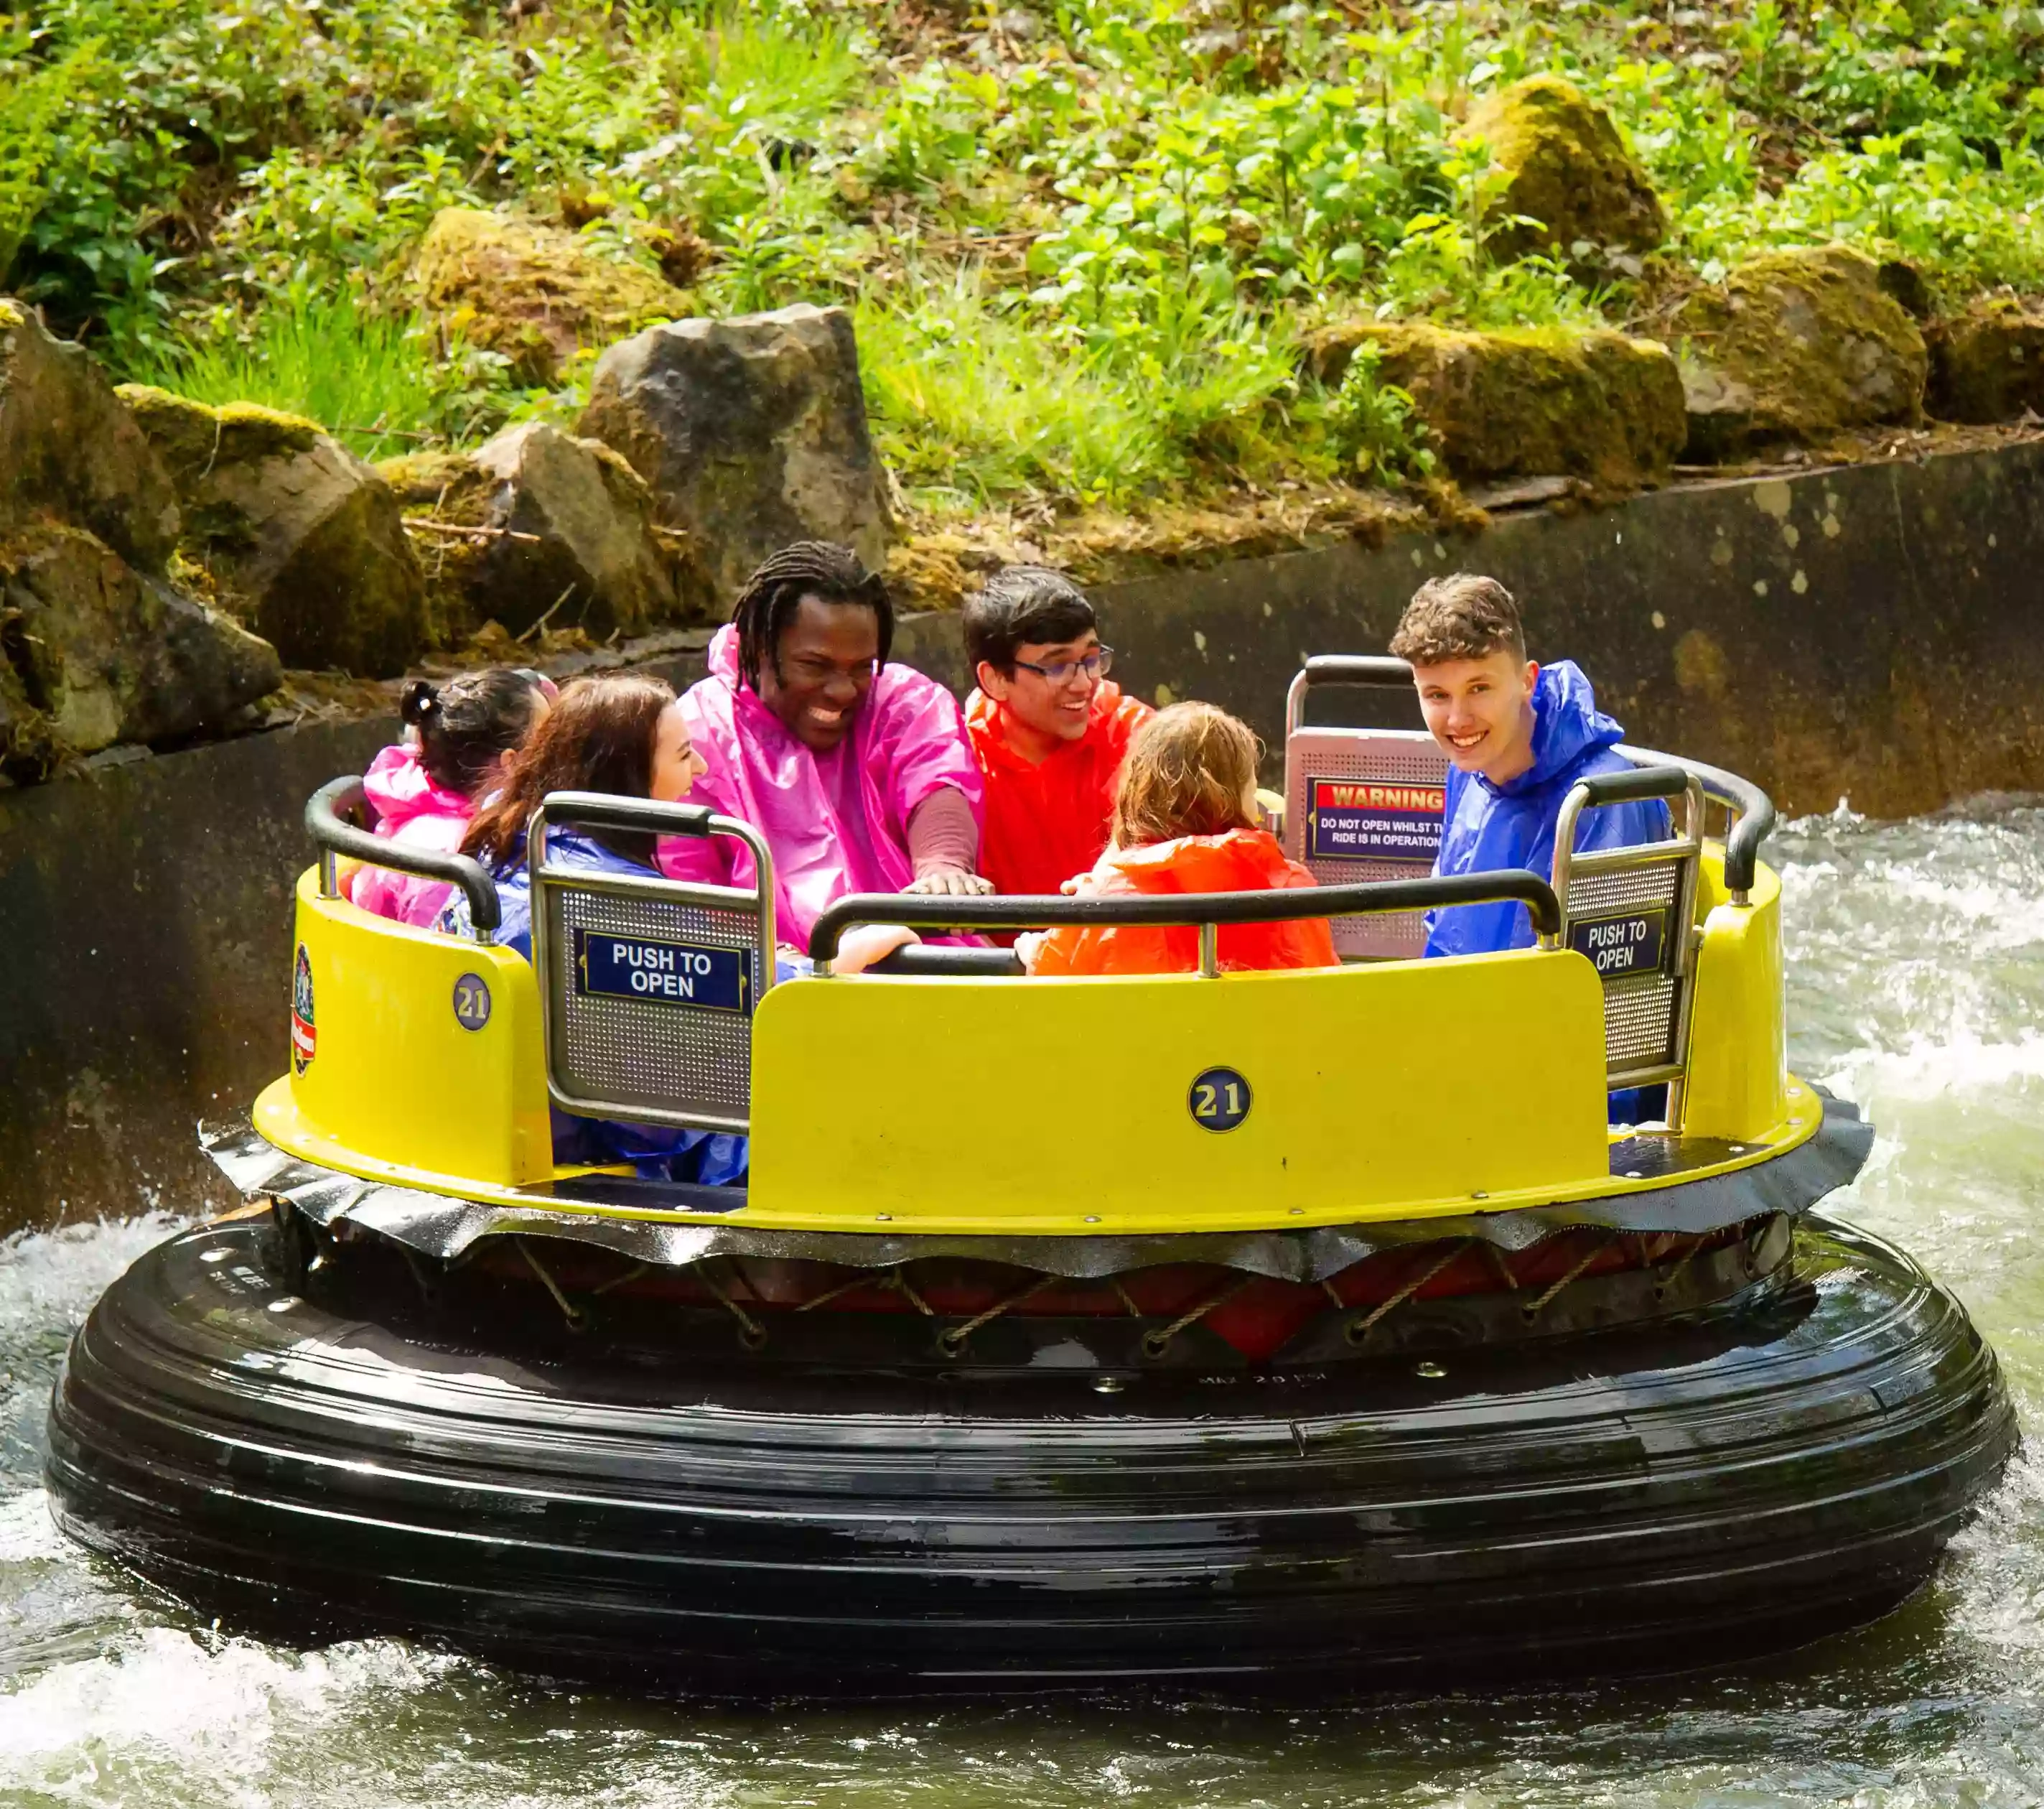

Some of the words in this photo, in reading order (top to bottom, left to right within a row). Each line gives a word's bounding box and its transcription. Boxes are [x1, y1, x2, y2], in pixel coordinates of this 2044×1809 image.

[1332, 786, 1443, 811] WARNING
[1321, 817, 1337, 829] DO
[1338, 819, 1361, 829] NOT
[1362, 819, 1391, 832] OPEN
[1392, 822, 1432, 834] WHILST
[1332, 833, 1356, 844] RIDE
[1358, 834, 1368, 845] IS
[1371, 834, 1381, 845] IN
[1588, 923, 1625, 949] PUSH
[1628, 920, 1647, 941] TO
[612, 943, 674, 971] PUSH
[680, 951, 711, 975] TO
[1596, 946, 1634, 971] OPEN
[630, 970, 694, 997] OPEN
[458, 986, 486, 1020] 21
[1195, 1082, 1242, 1117] 21
